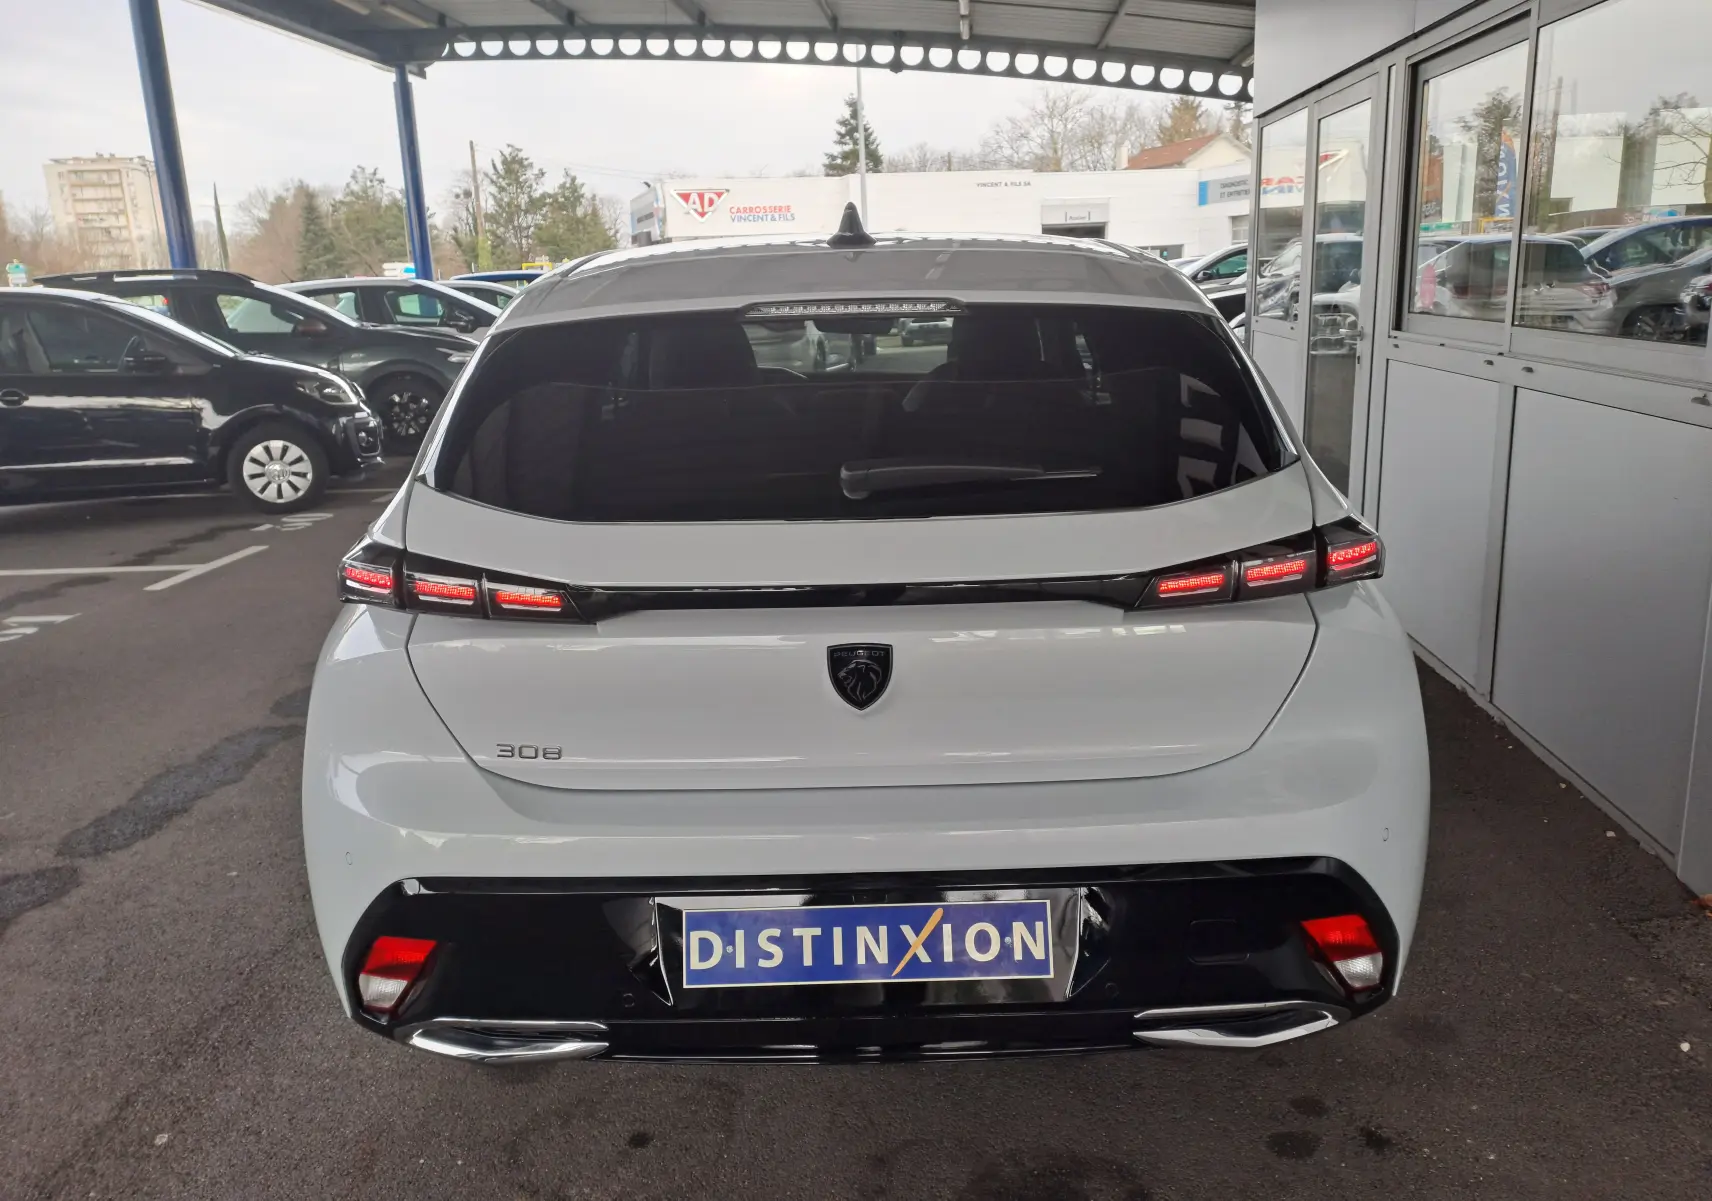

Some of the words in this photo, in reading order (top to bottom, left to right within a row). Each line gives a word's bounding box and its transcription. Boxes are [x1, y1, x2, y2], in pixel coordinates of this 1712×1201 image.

[685, 192, 719, 214] AD
[729, 205, 791, 215] CARROSSERIE
[730, 214, 769, 223] VINCENT
[770, 213, 777, 222] &
[778, 213, 796, 222] FILS
[833, 649, 885, 657] PEUGEOT
[496, 743, 563, 760] 308
[689, 907, 1046, 977] DISTINXION
